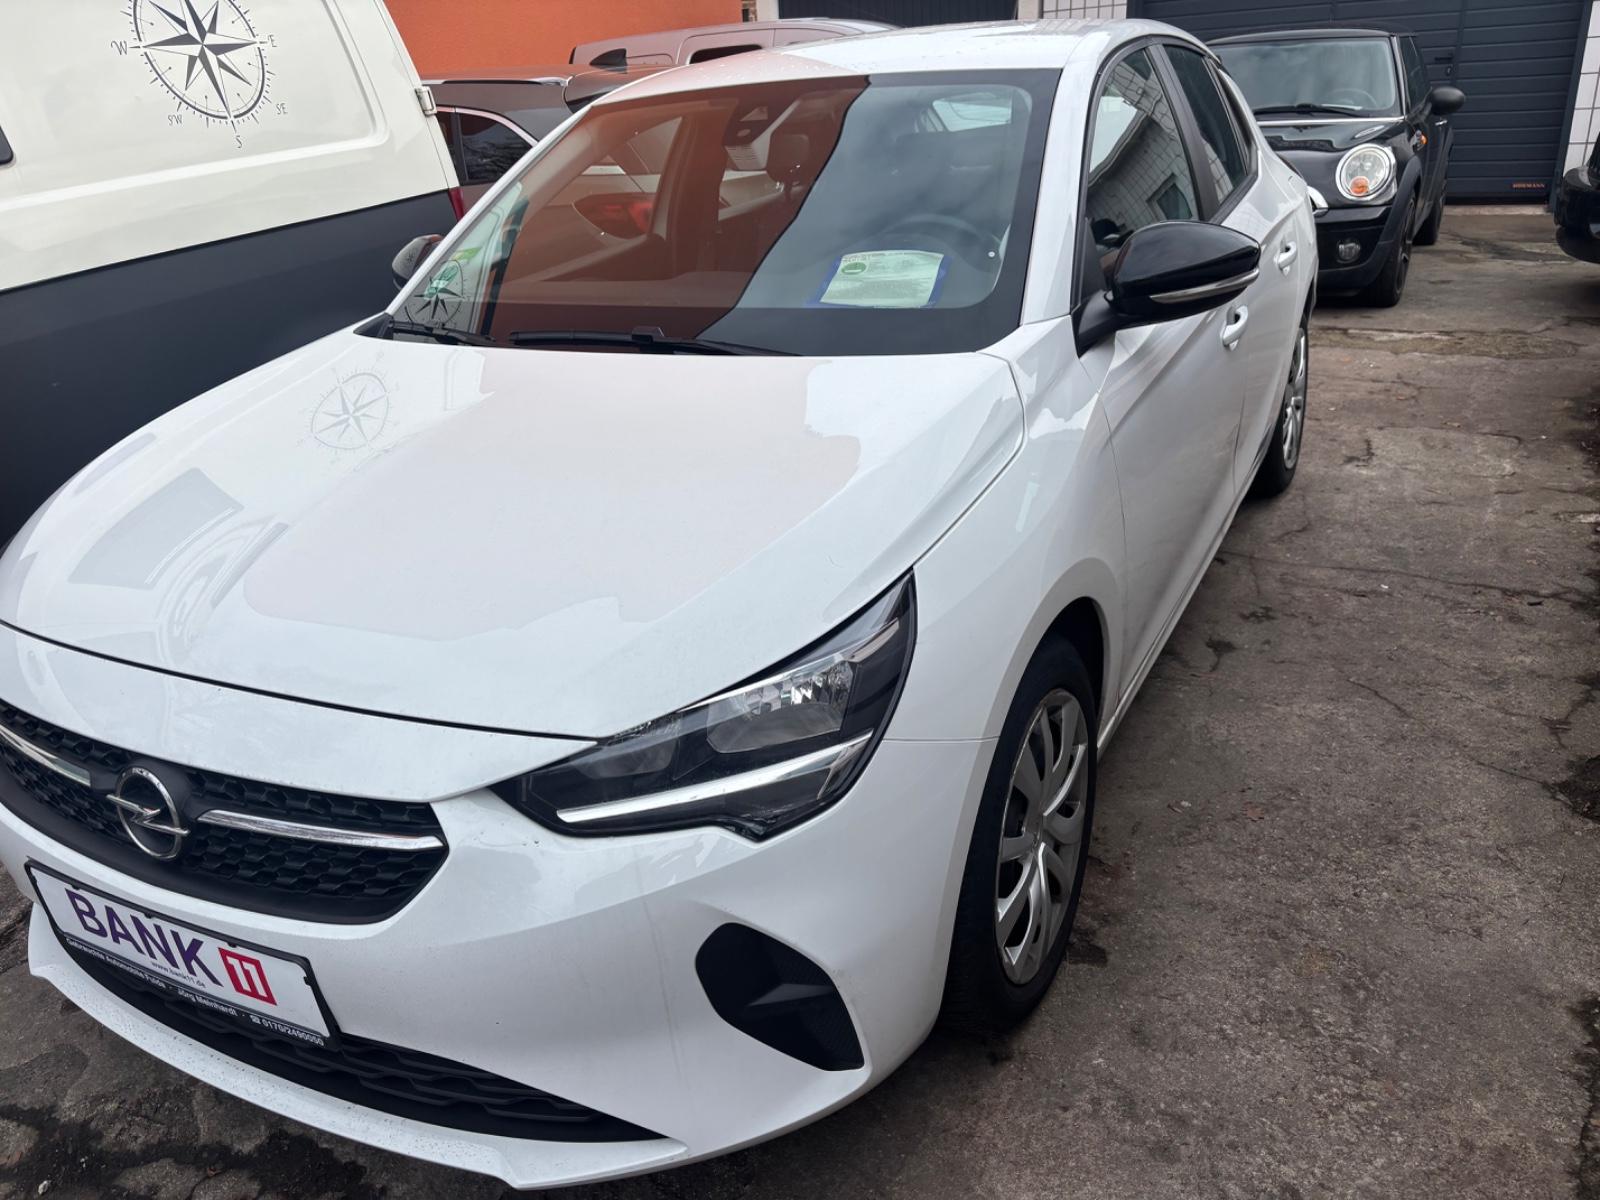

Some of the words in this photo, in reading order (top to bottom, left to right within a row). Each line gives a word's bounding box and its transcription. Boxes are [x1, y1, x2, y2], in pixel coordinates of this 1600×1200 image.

[110, 40, 128, 56] W
[276, 102, 289, 116] SE
[167, 114, 184, 126] SW
[235, 135, 243, 149] S
[65, 888, 224, 988] BANK
